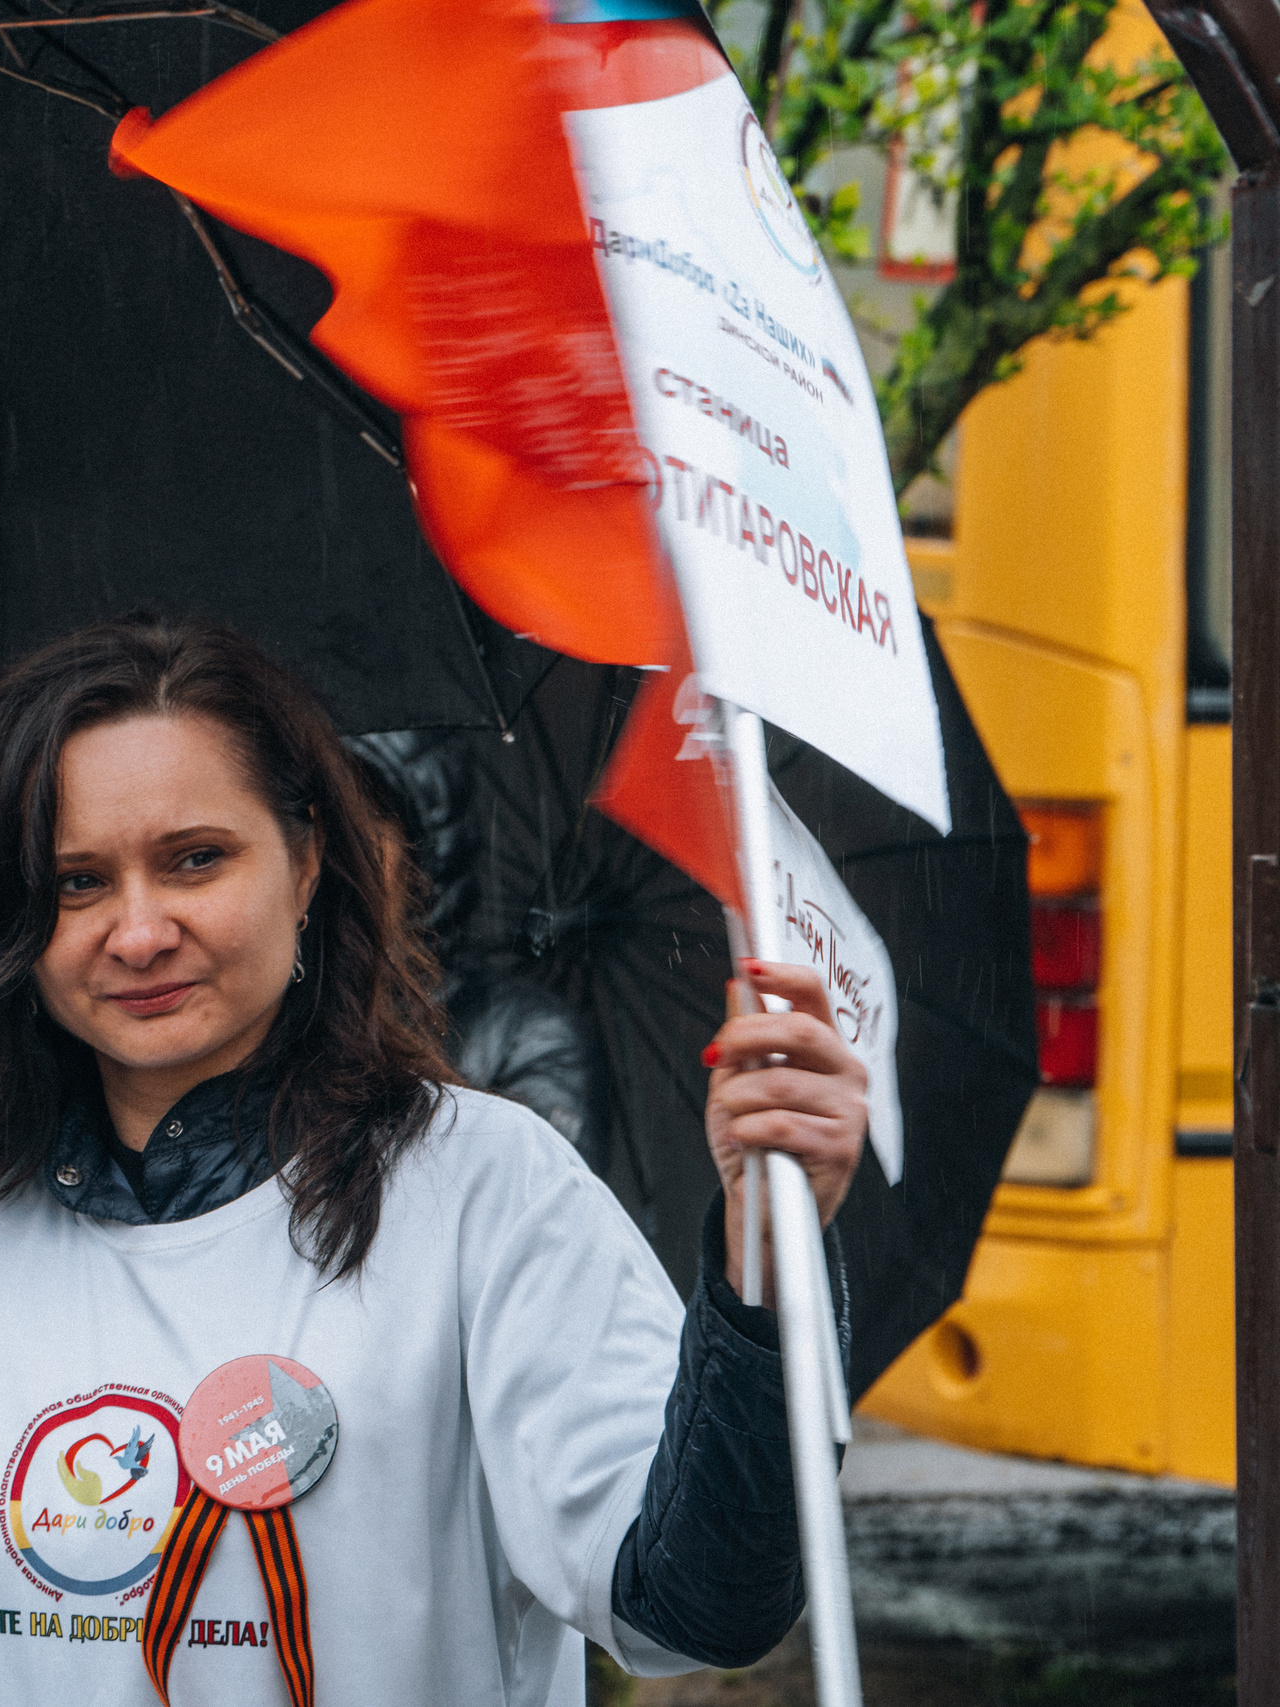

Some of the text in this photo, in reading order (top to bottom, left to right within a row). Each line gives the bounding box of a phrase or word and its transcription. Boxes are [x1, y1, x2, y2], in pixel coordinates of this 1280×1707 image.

[782, 362, 824, 404] РАЙОН
[654, 367, 789, 469] станица
[66, 1383, 150, 1405] общественная
[151, 1389, 185, 1417] организа
[218, 1395, 265, 1426] 1941-1945
[205, 1419, 287, 1478] 9 МАЯ
[218, 1444, 296, 1496] ДЕНЬ ПОБЕДЫ
[32, 1508, 155, 1538] Дари добро
[30, 1612, 64, 1638] НА
[69, 1614, 179, 1644] ДОБР
[188, 1619, 269, 1648] ДЕЛА!
